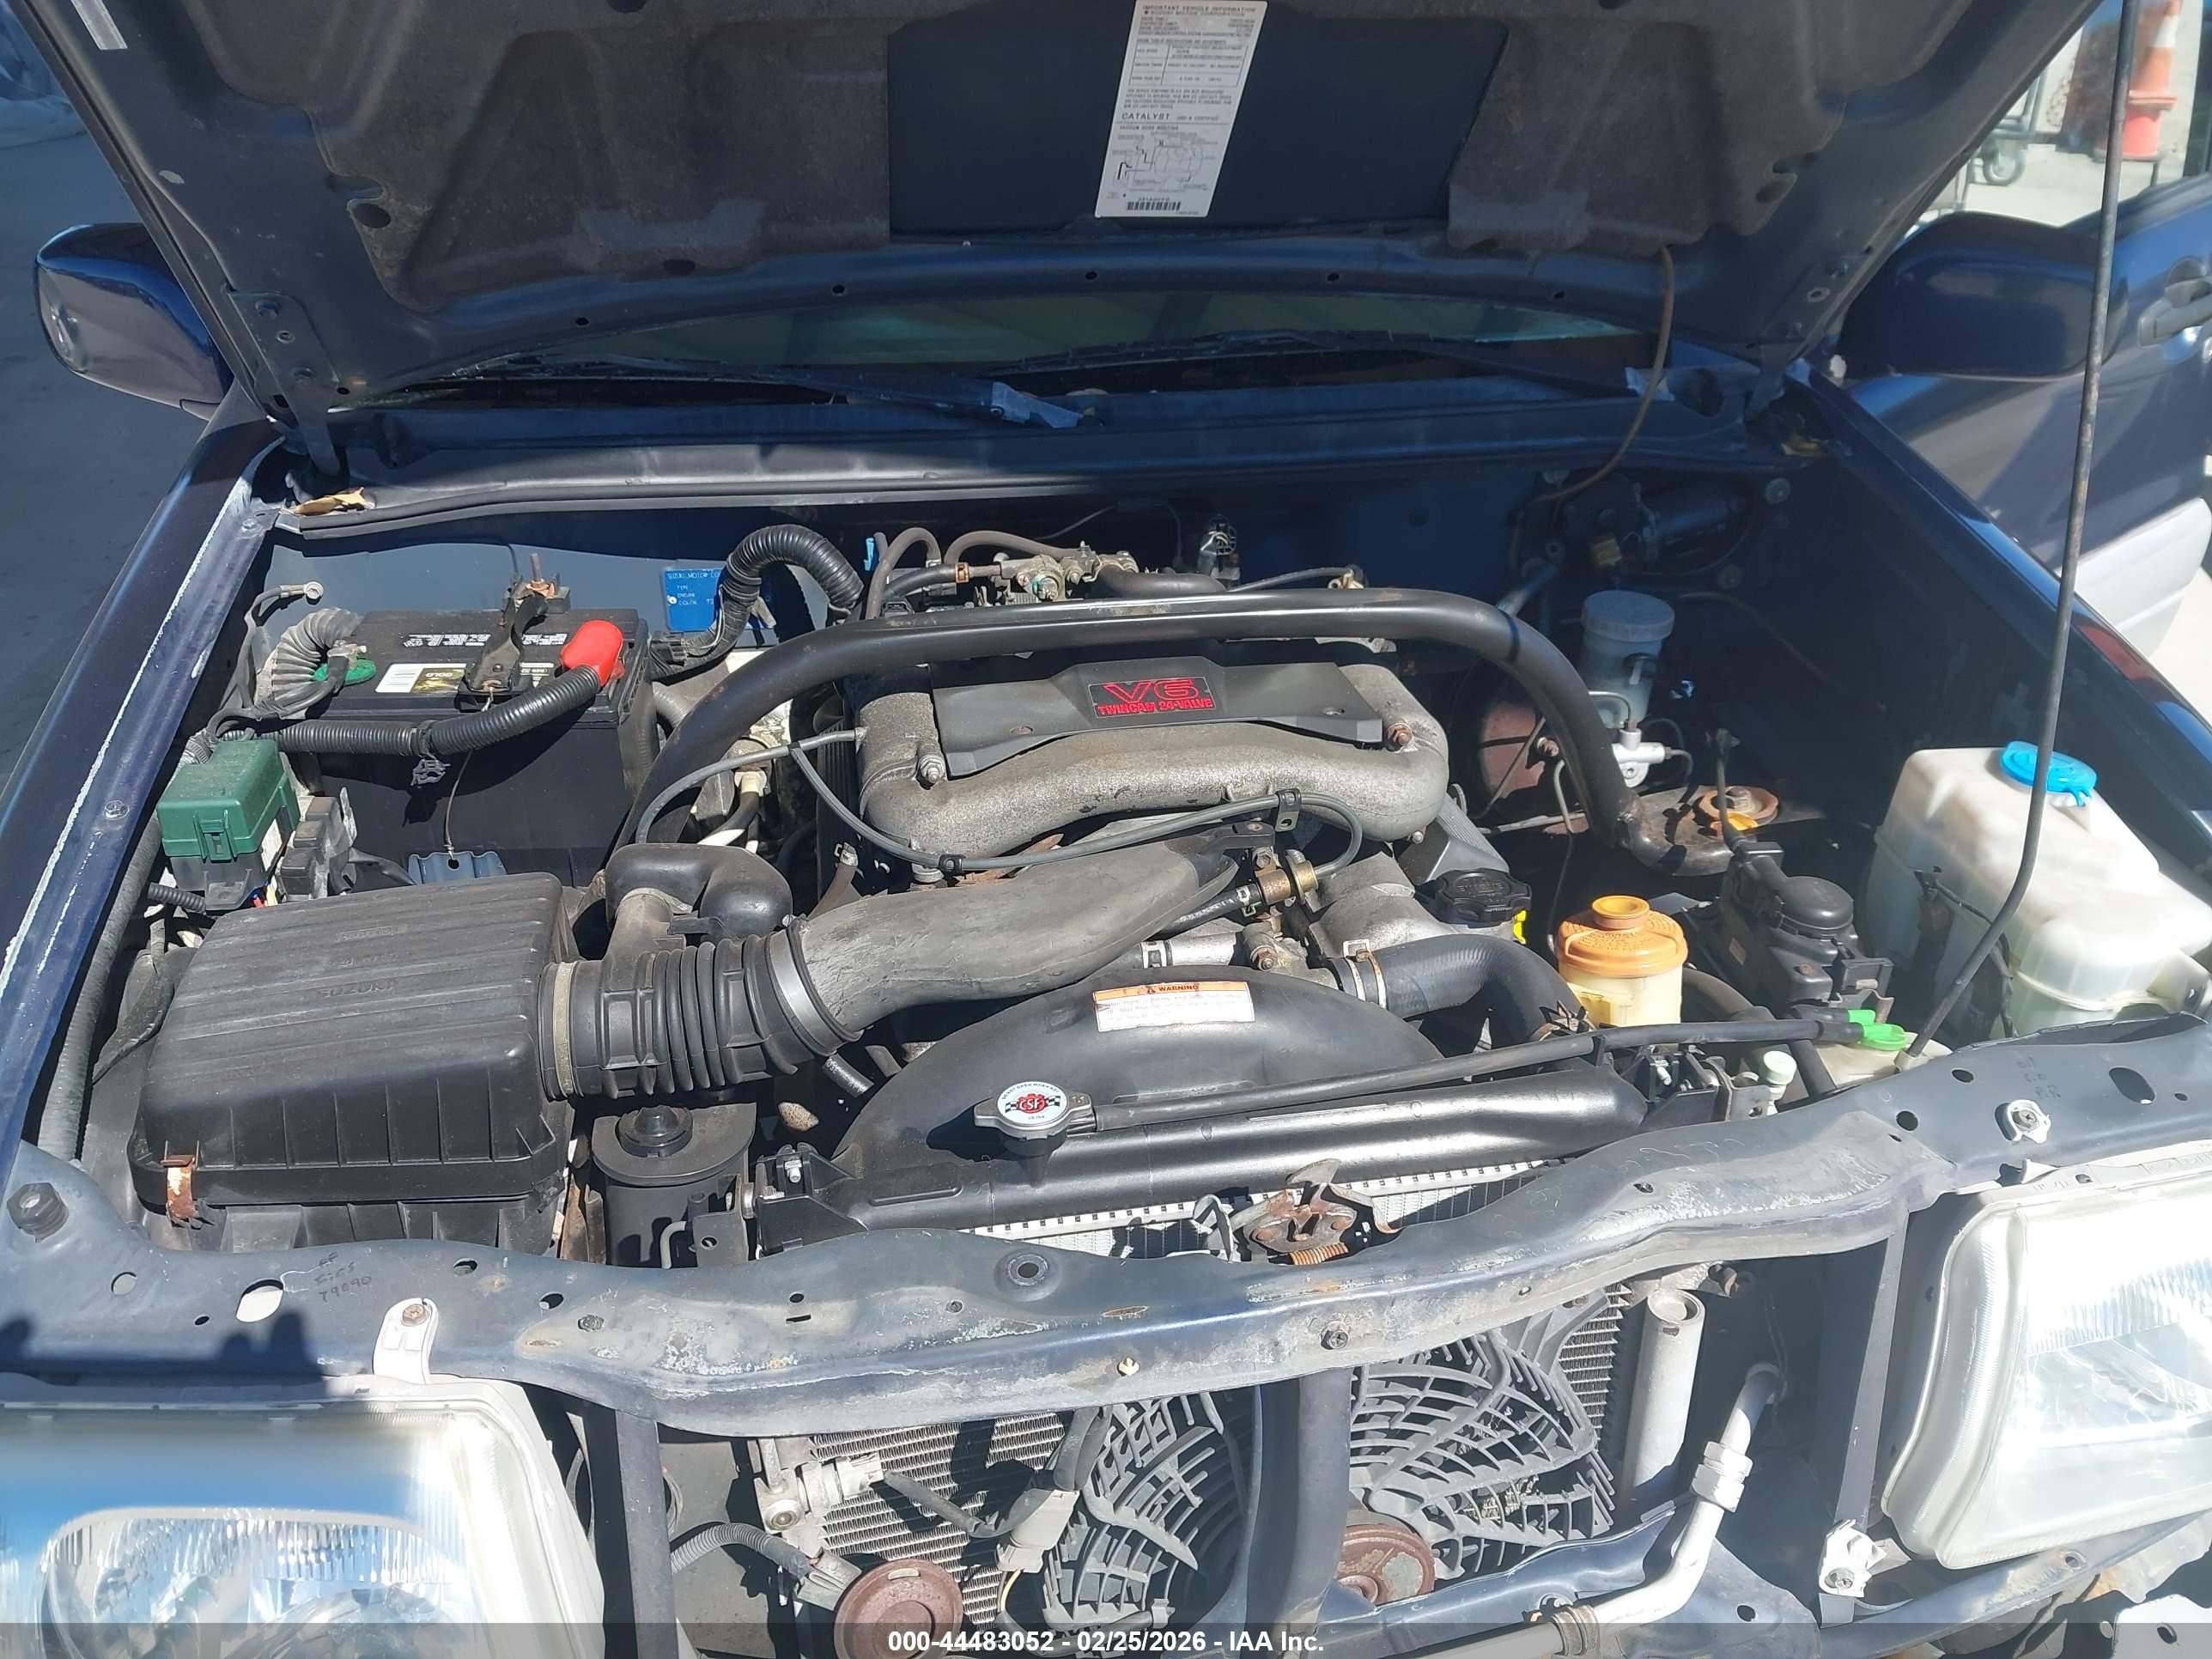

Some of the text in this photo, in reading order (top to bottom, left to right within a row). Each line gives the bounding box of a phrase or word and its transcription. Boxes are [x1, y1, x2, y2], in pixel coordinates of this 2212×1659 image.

[1103, 678, 1200, 704] V6
[1098, 697, 1213, 715] TWINCAM 24-VALVE
[1158, 983, 1200, 992] WARNING
[1019, 1097, 1042, 1111] CSF
